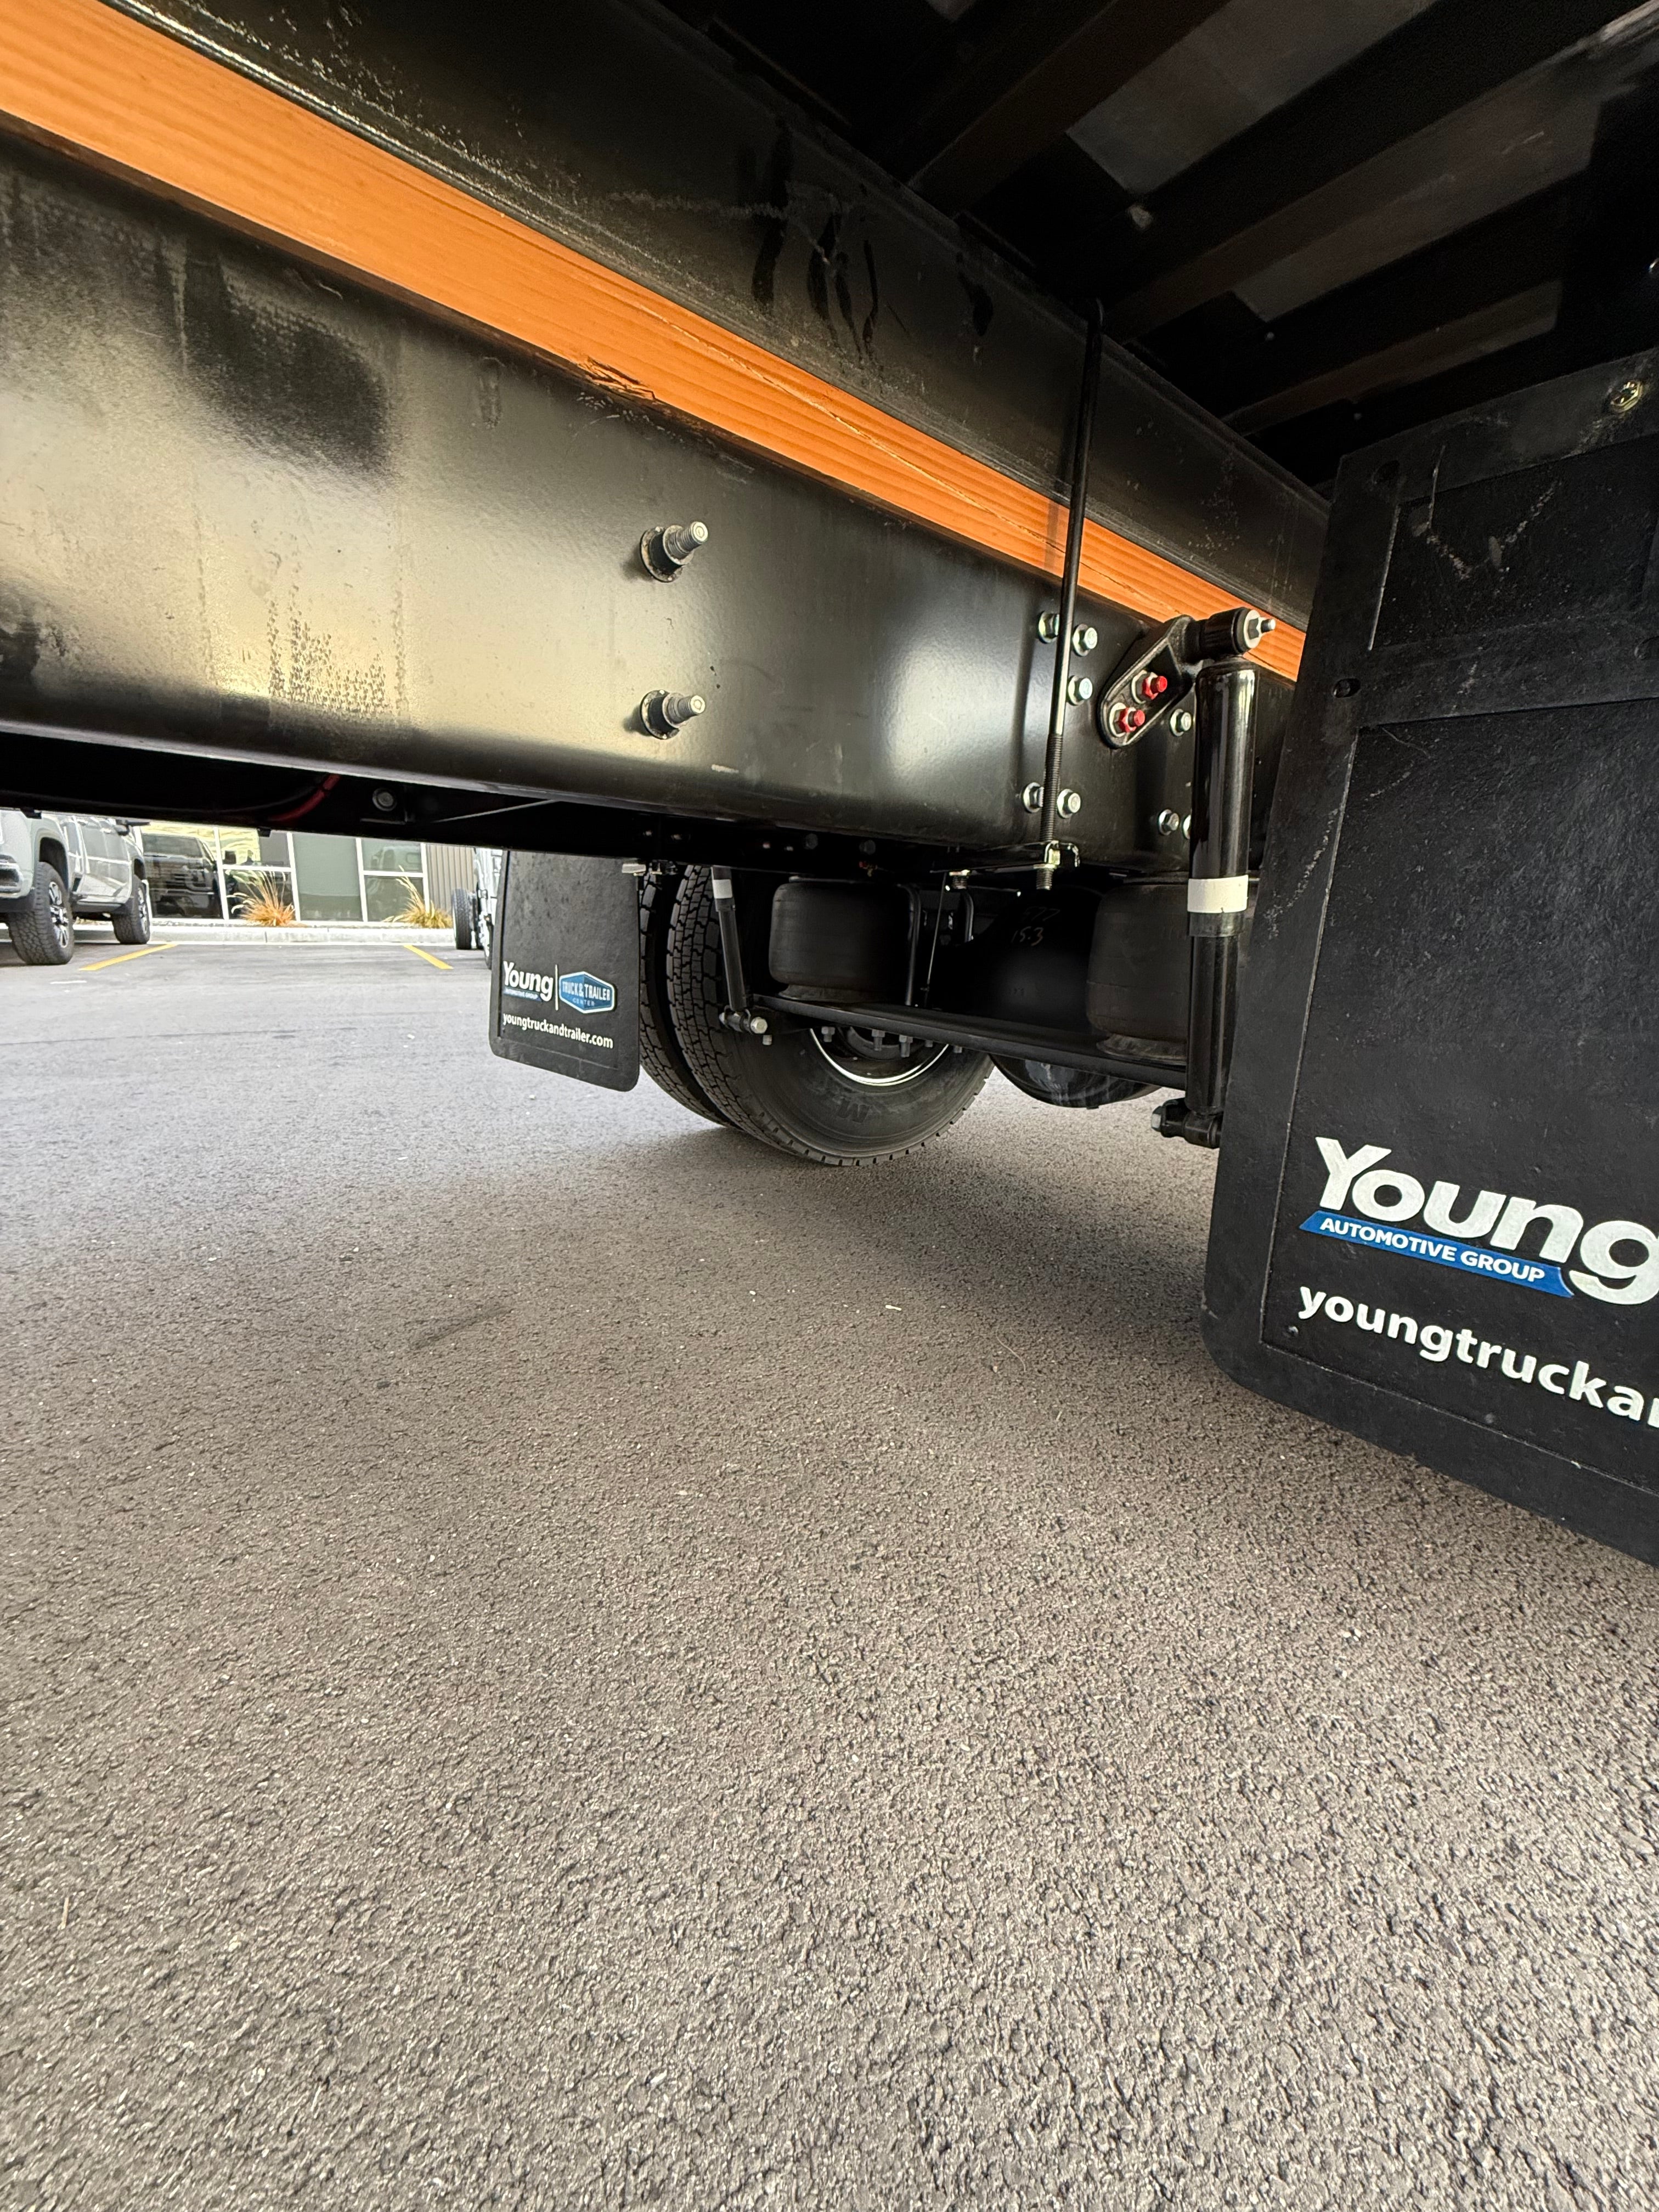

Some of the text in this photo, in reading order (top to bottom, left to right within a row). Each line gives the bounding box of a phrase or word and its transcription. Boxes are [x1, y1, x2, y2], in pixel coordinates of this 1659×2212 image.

[503, 961, 554, 1002] Young
[562, 981, 578, 996] TRUCK
[584, 984, 611, 1001] TRAILER
[572, 998, 595, 1006] CENTER
[503, 1013, 613, 1049] youngtruckandtrailer.com
[1314, 1137, 1659, 1305] Young
[1320, 1217, 1545, 1283] AUTOMOTIVE GROUP
